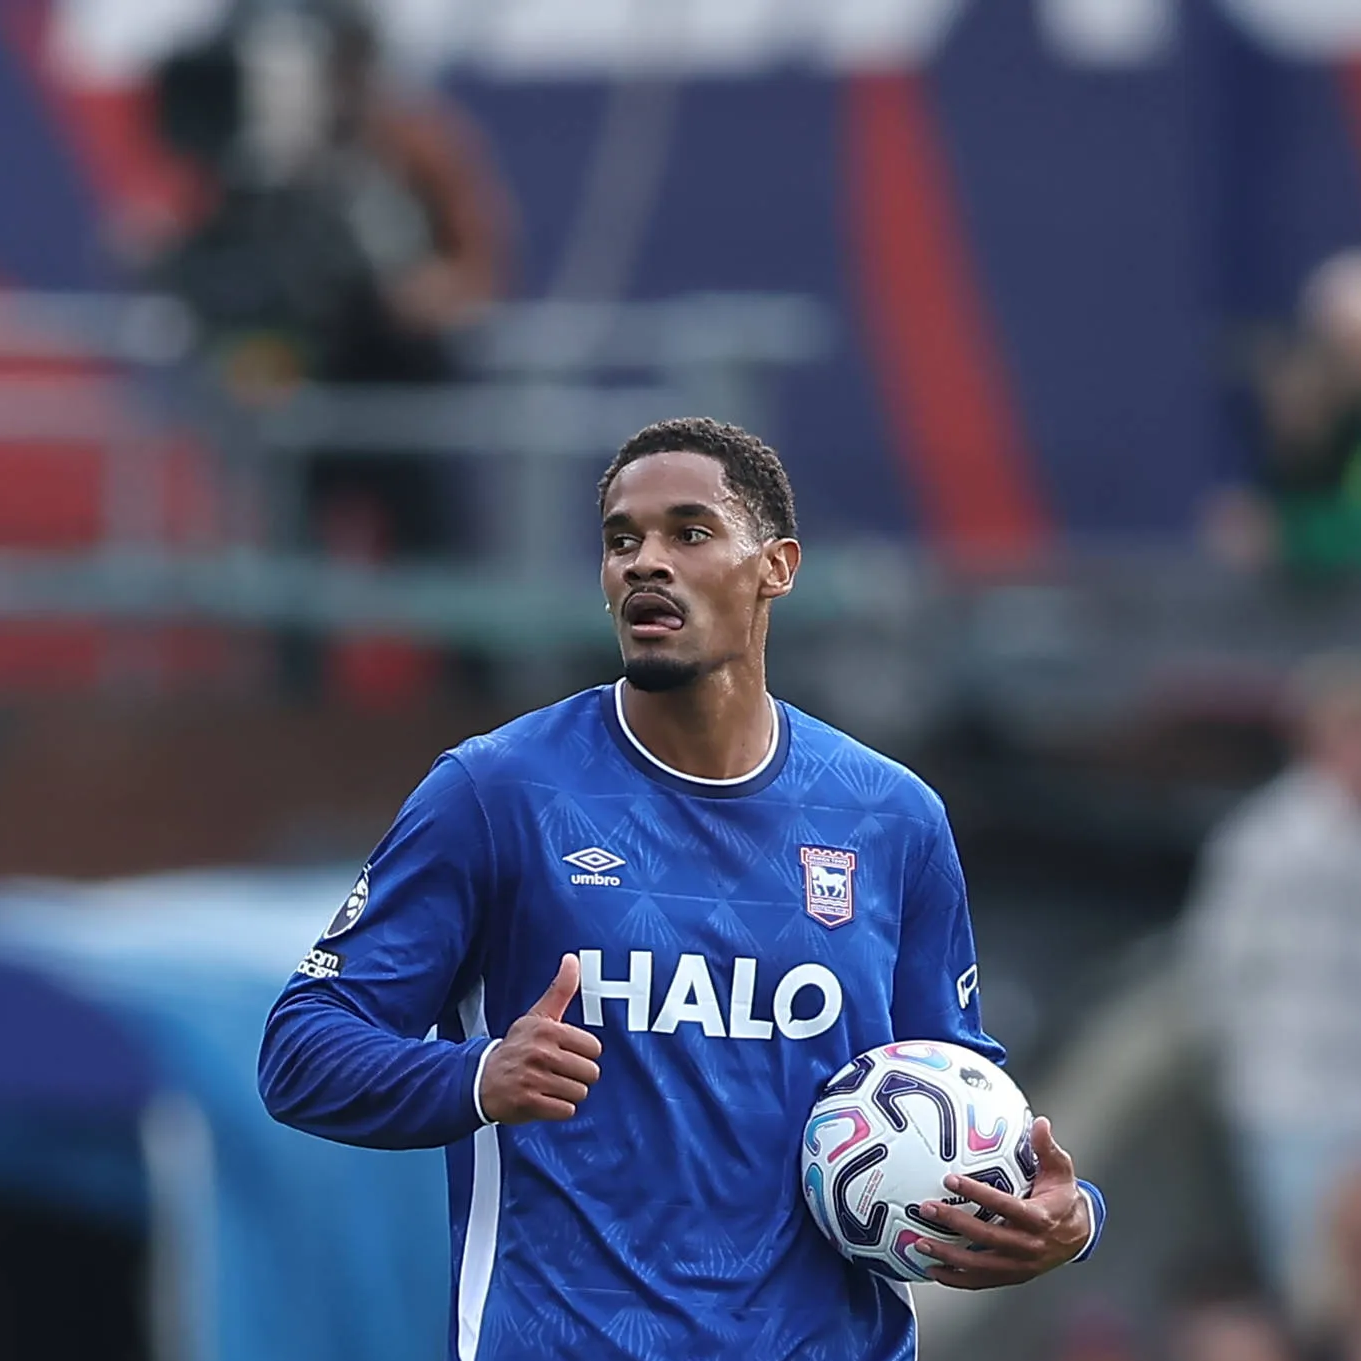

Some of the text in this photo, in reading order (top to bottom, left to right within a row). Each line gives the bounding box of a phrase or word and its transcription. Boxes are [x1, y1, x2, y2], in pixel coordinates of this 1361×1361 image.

[570, 873, 621, 887] umbro
[305, 946, 339, 970] om
[296, 960, 340, 979] acism
[579, 949, 843, 1040] HALO
